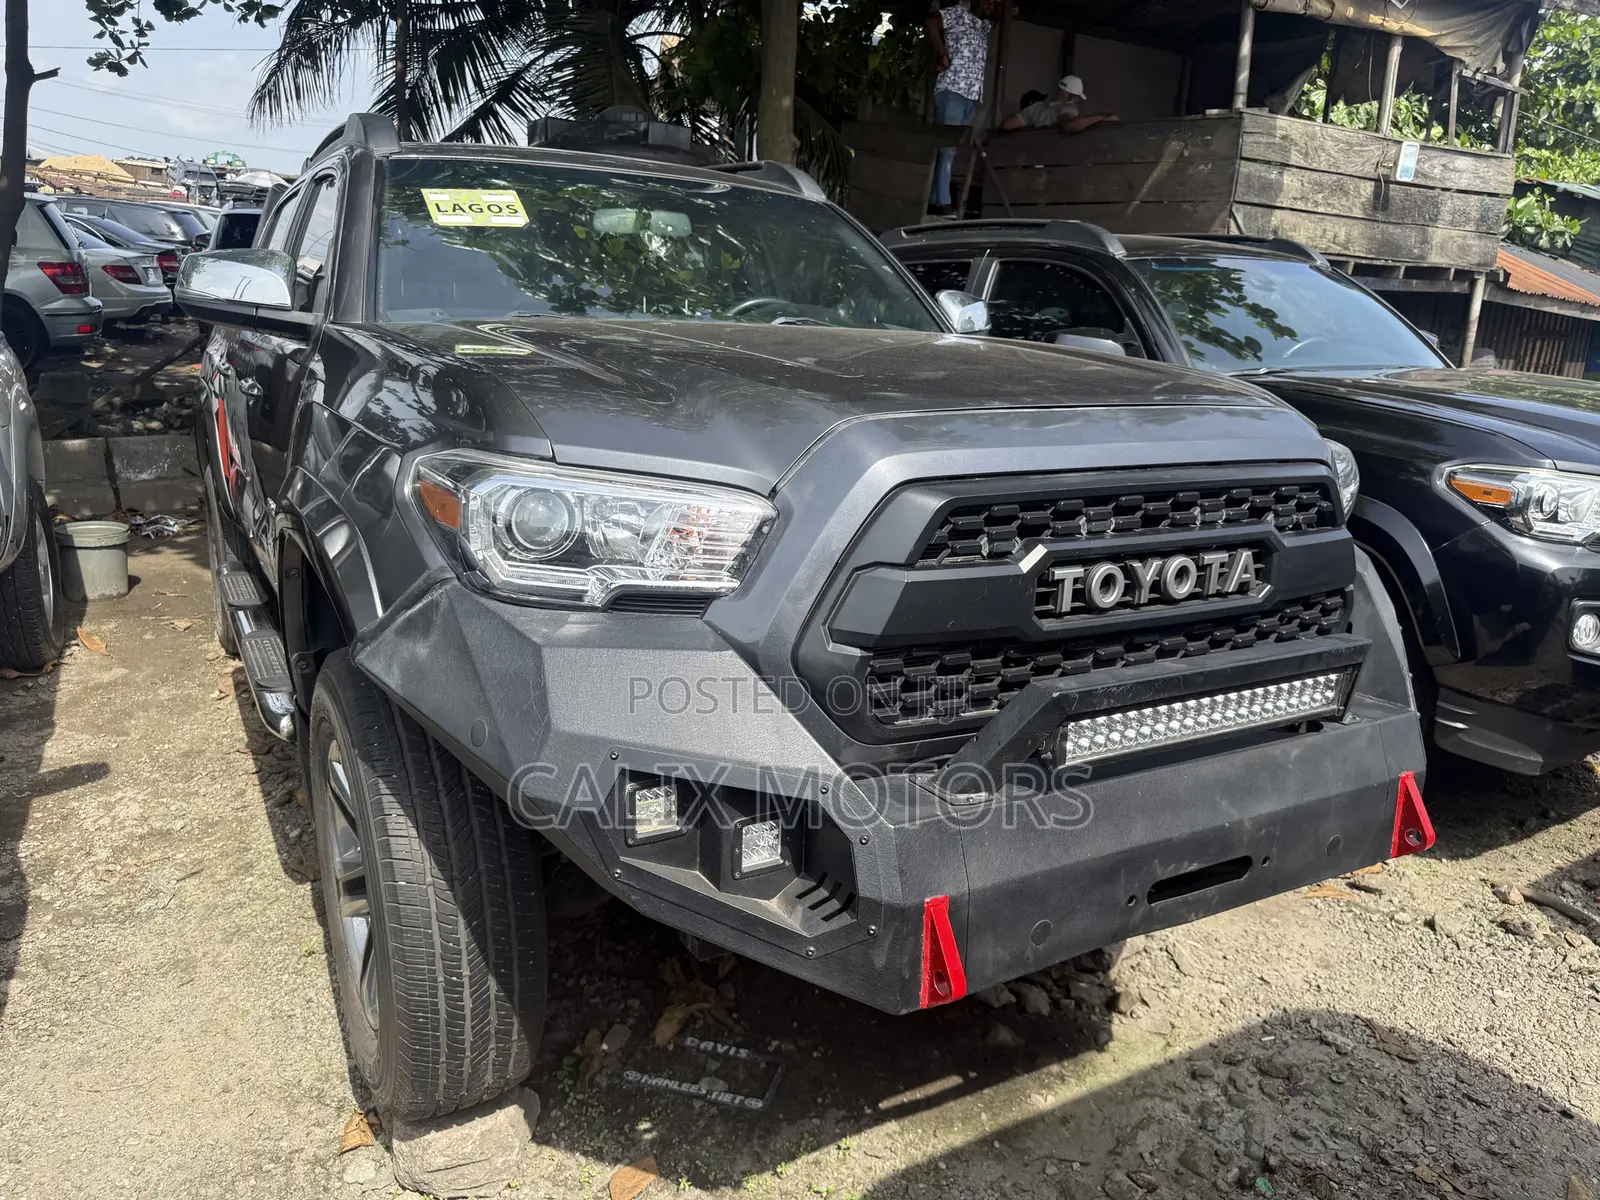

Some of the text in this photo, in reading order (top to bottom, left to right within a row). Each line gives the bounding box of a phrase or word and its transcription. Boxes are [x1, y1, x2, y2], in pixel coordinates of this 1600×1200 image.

[434, 202, 519, 214] LAGOS
[1050, 548, 1257, 614] TOYOTA
[684, 1036, 750, 1059] DAVIS
